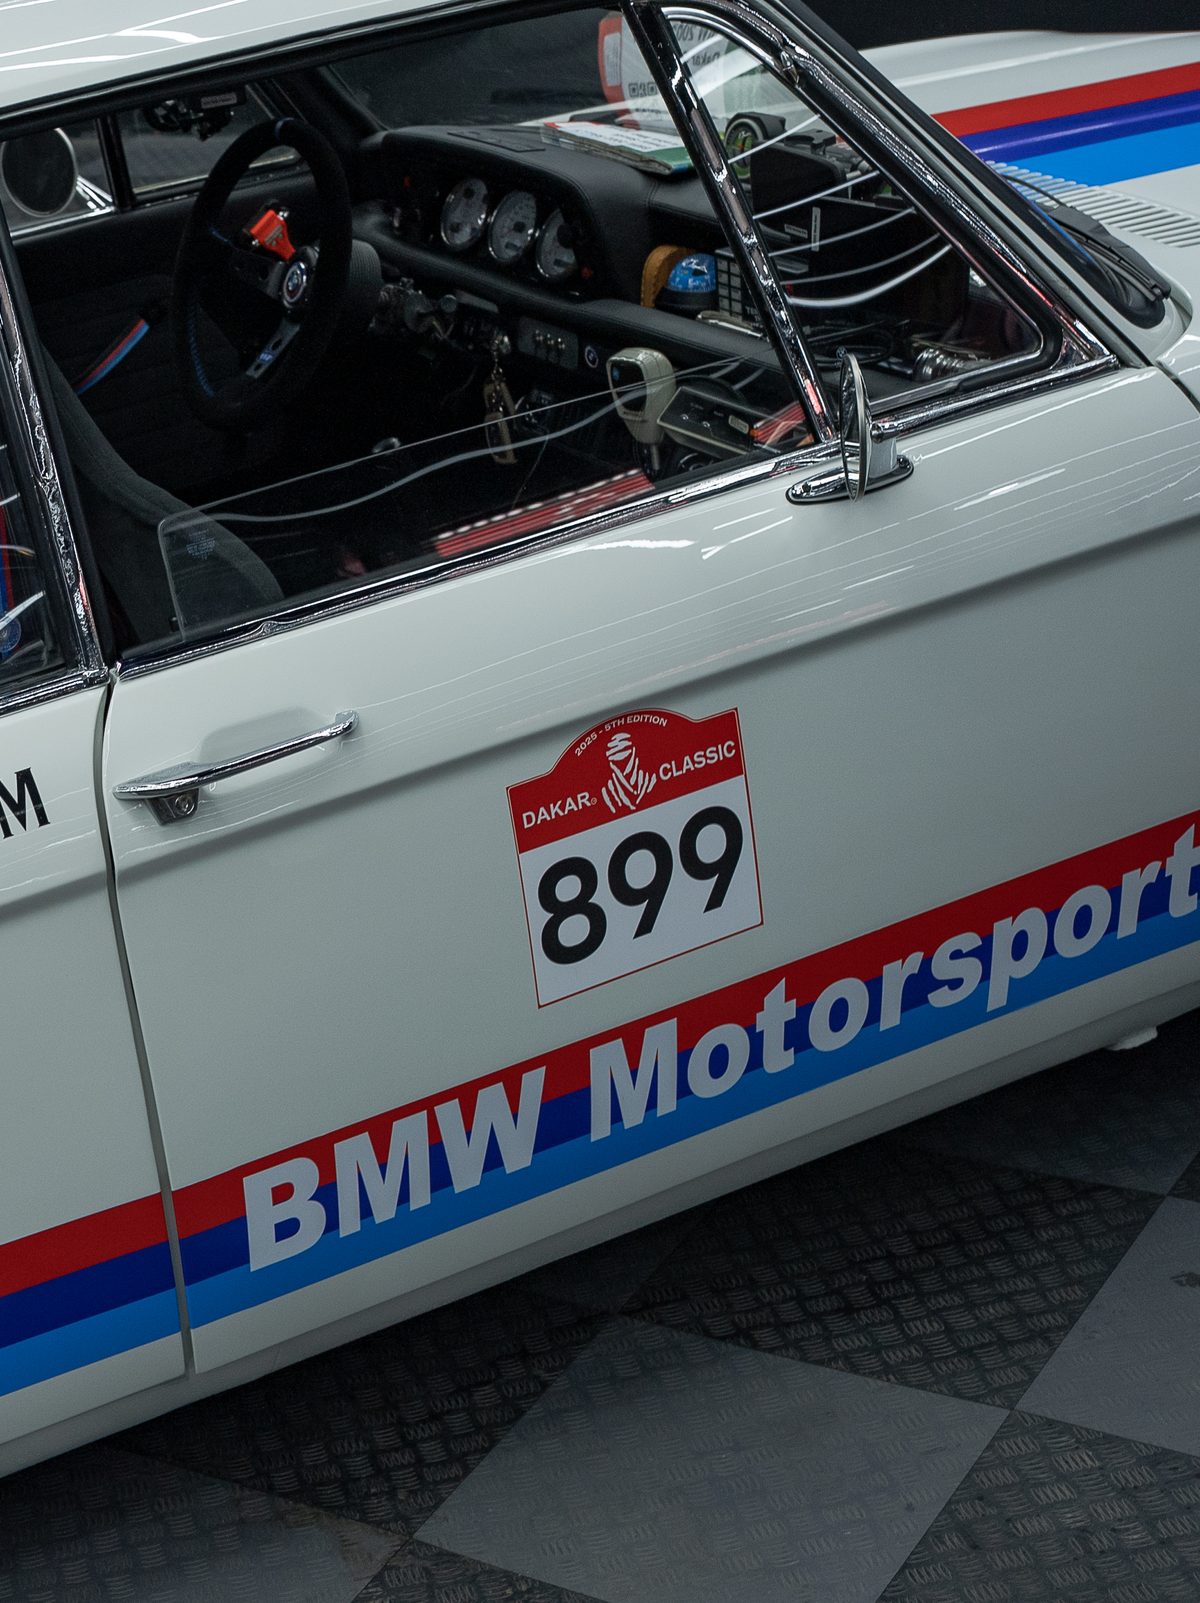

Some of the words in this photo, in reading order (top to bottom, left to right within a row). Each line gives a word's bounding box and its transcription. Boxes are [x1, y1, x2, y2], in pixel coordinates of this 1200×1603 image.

[522, 790, 592, 829] DAKAR
[658, 740, 736, 781] CLASSIC
[574, 731, 598, 757] 2025
[604, 718, 626, 733] 5TH
[626, 714, 668, 728] EDITION
[537, 805, 743, 965] 899
[240, 1065, 546, 1273] BMW
[589, 823, 1200, 1142] Motorsport
